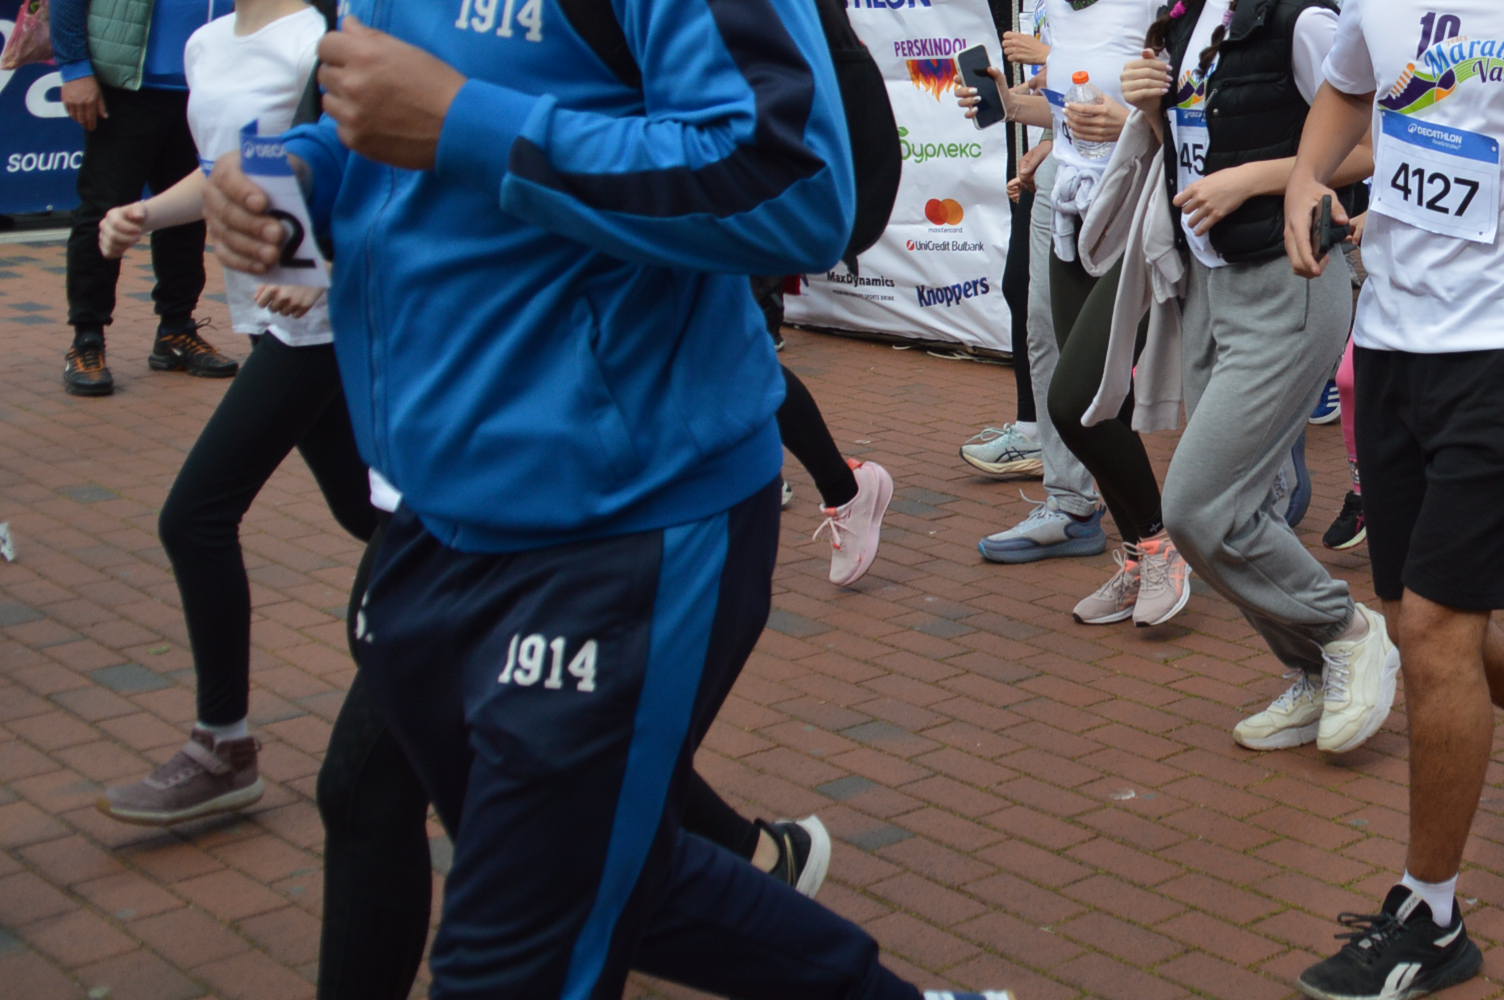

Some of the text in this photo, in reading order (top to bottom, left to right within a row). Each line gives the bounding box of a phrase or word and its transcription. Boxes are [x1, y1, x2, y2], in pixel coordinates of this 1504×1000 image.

[1416, 11, 1462, 60] 10
[1417, 126, 1463, 145] DECATHLON
[1180, 142, 1206, 176] 45
[1390, 162, 1480, 217] 4127
[915, 240, 985, 252] UniCredit Bulbank
[826, 271, 895, 288] MaxDynamics
[916, 277, 990, 308] Knoppers
[497, 632, 598, 692] 1914
